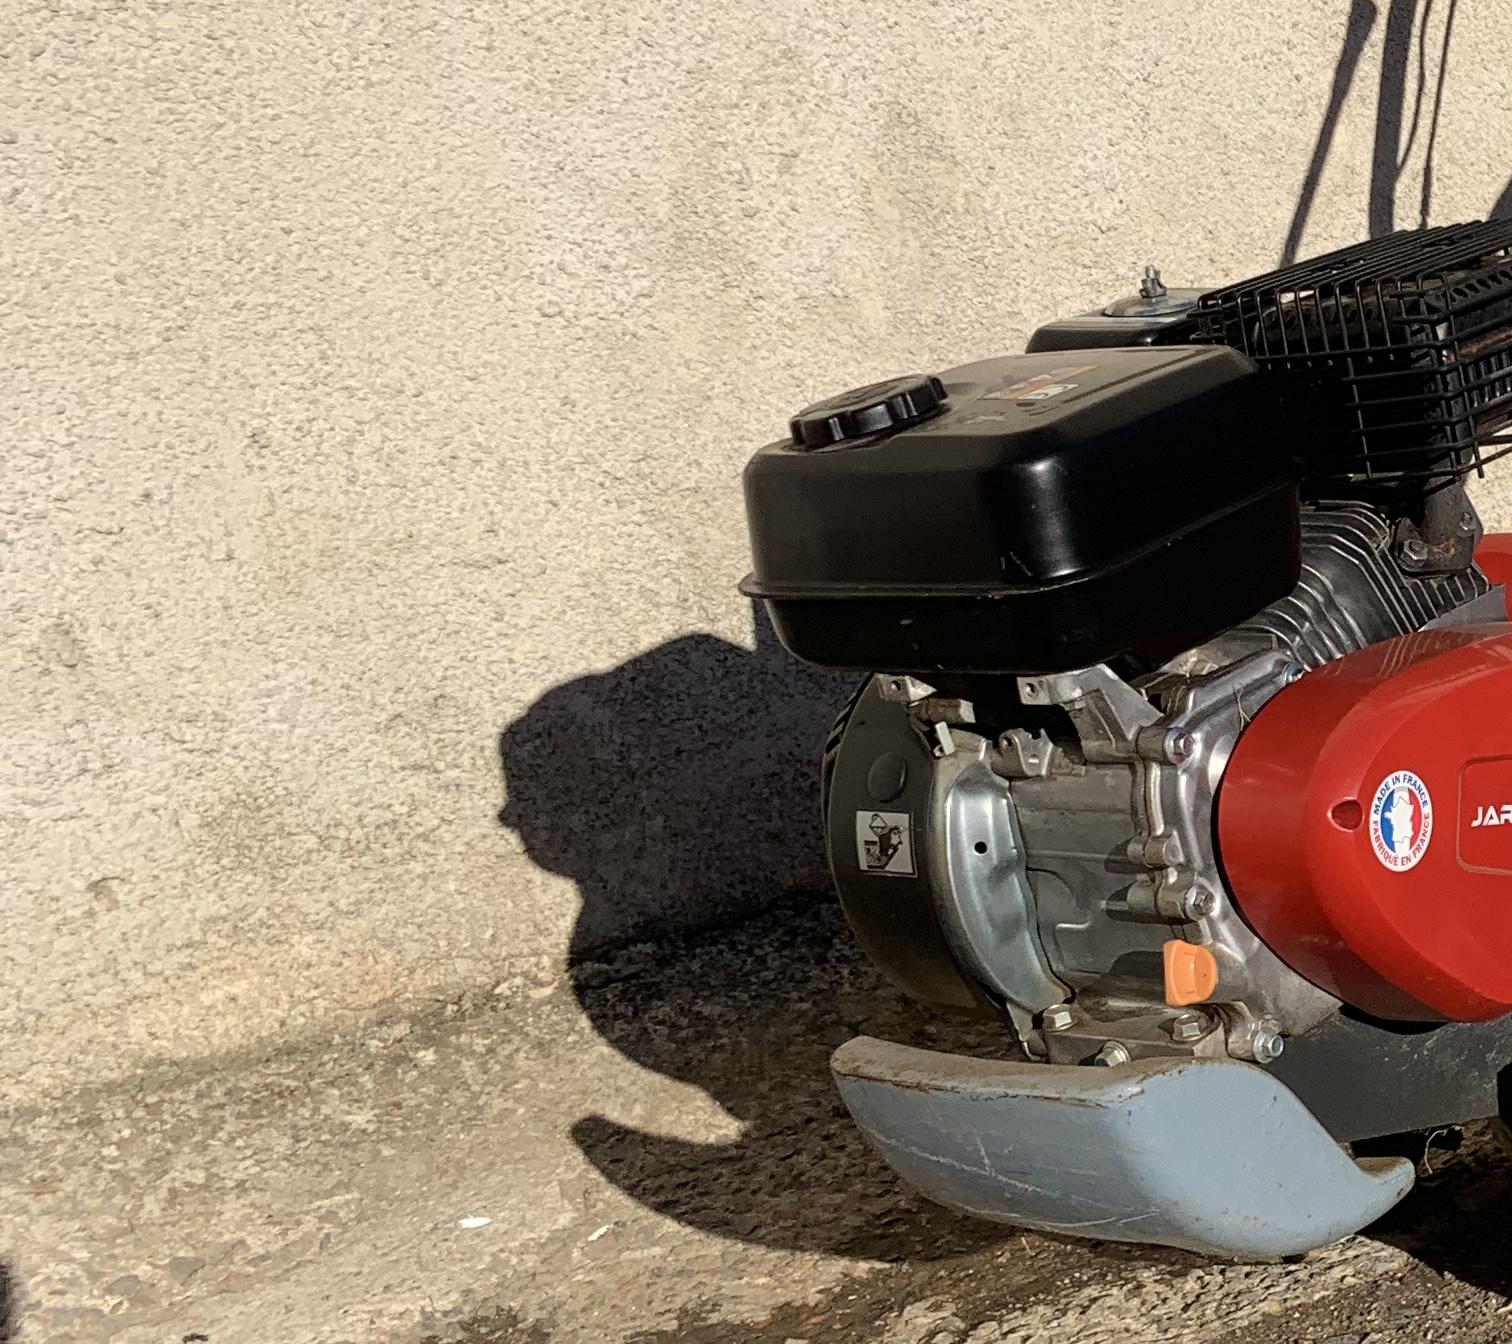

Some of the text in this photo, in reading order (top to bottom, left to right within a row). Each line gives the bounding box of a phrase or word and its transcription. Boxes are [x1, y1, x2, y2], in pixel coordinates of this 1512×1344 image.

[1373, 773, 1429, 816] MADE IN FRANCE
[1400, 854, 1412, 867] EN
[1412, 812, 1430, 859] FRANCE
